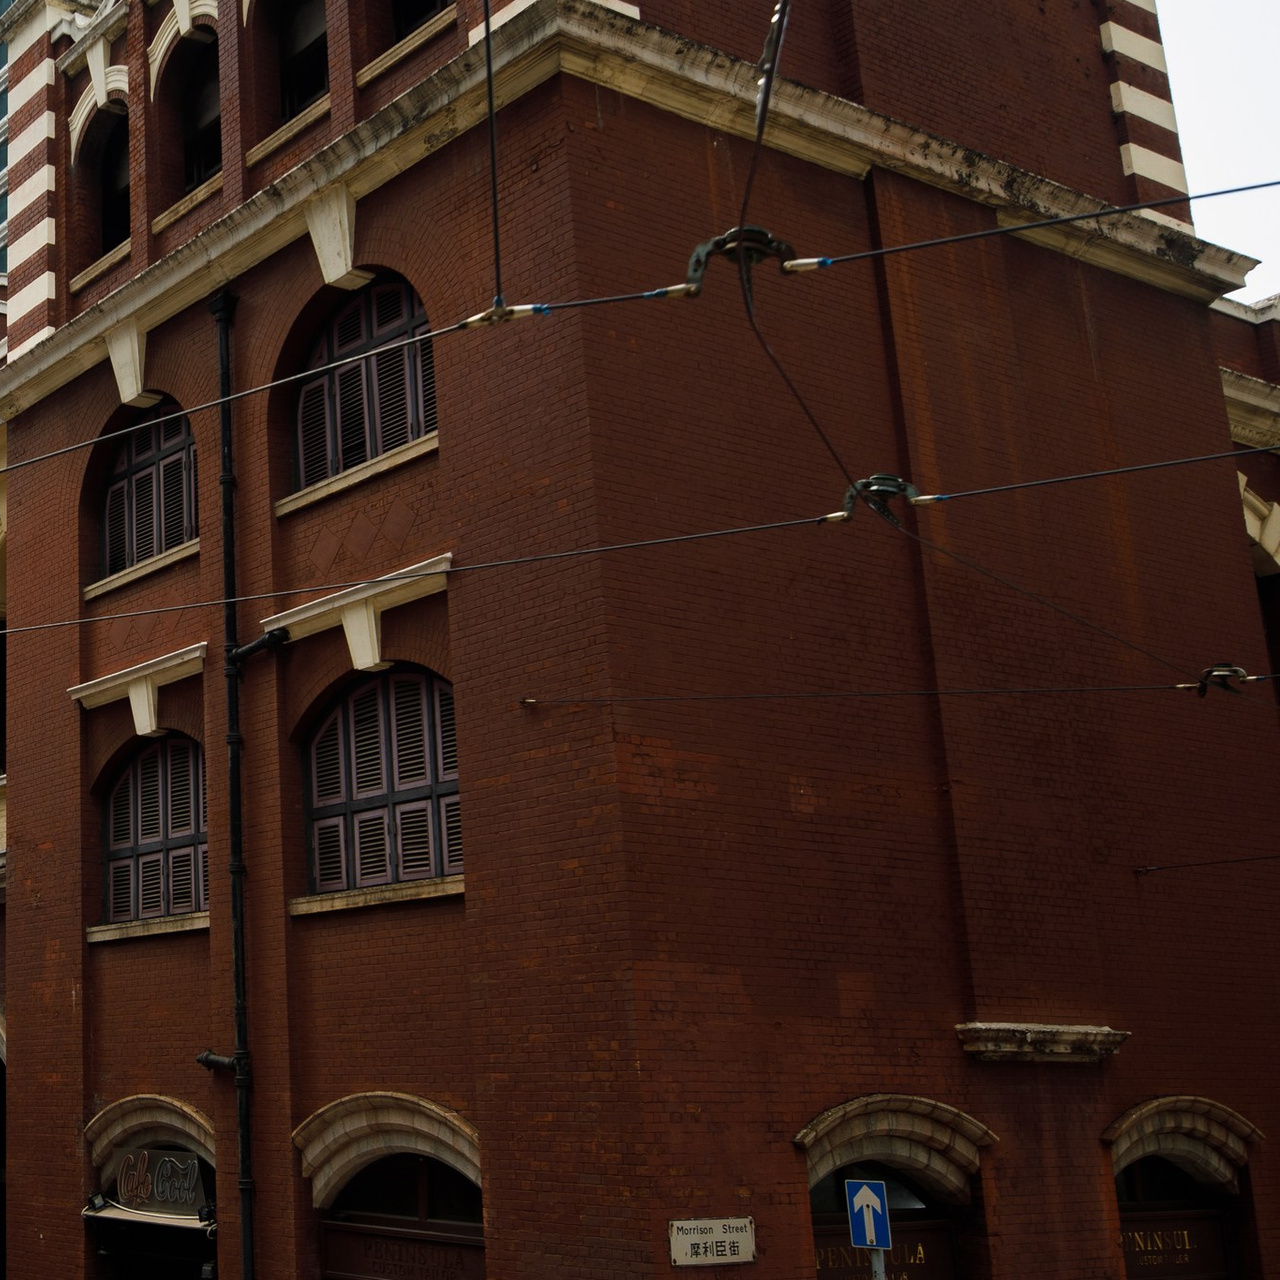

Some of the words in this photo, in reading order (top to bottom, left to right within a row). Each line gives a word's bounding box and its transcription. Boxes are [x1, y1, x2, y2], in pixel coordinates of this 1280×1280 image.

[154, 1157, 198, 1205] Cool
[676, 1225, 714, 1236] Morrison
[722, 1223, 748, 1234] Street
[690, 1240, 740, 1258] 摩利臣街
